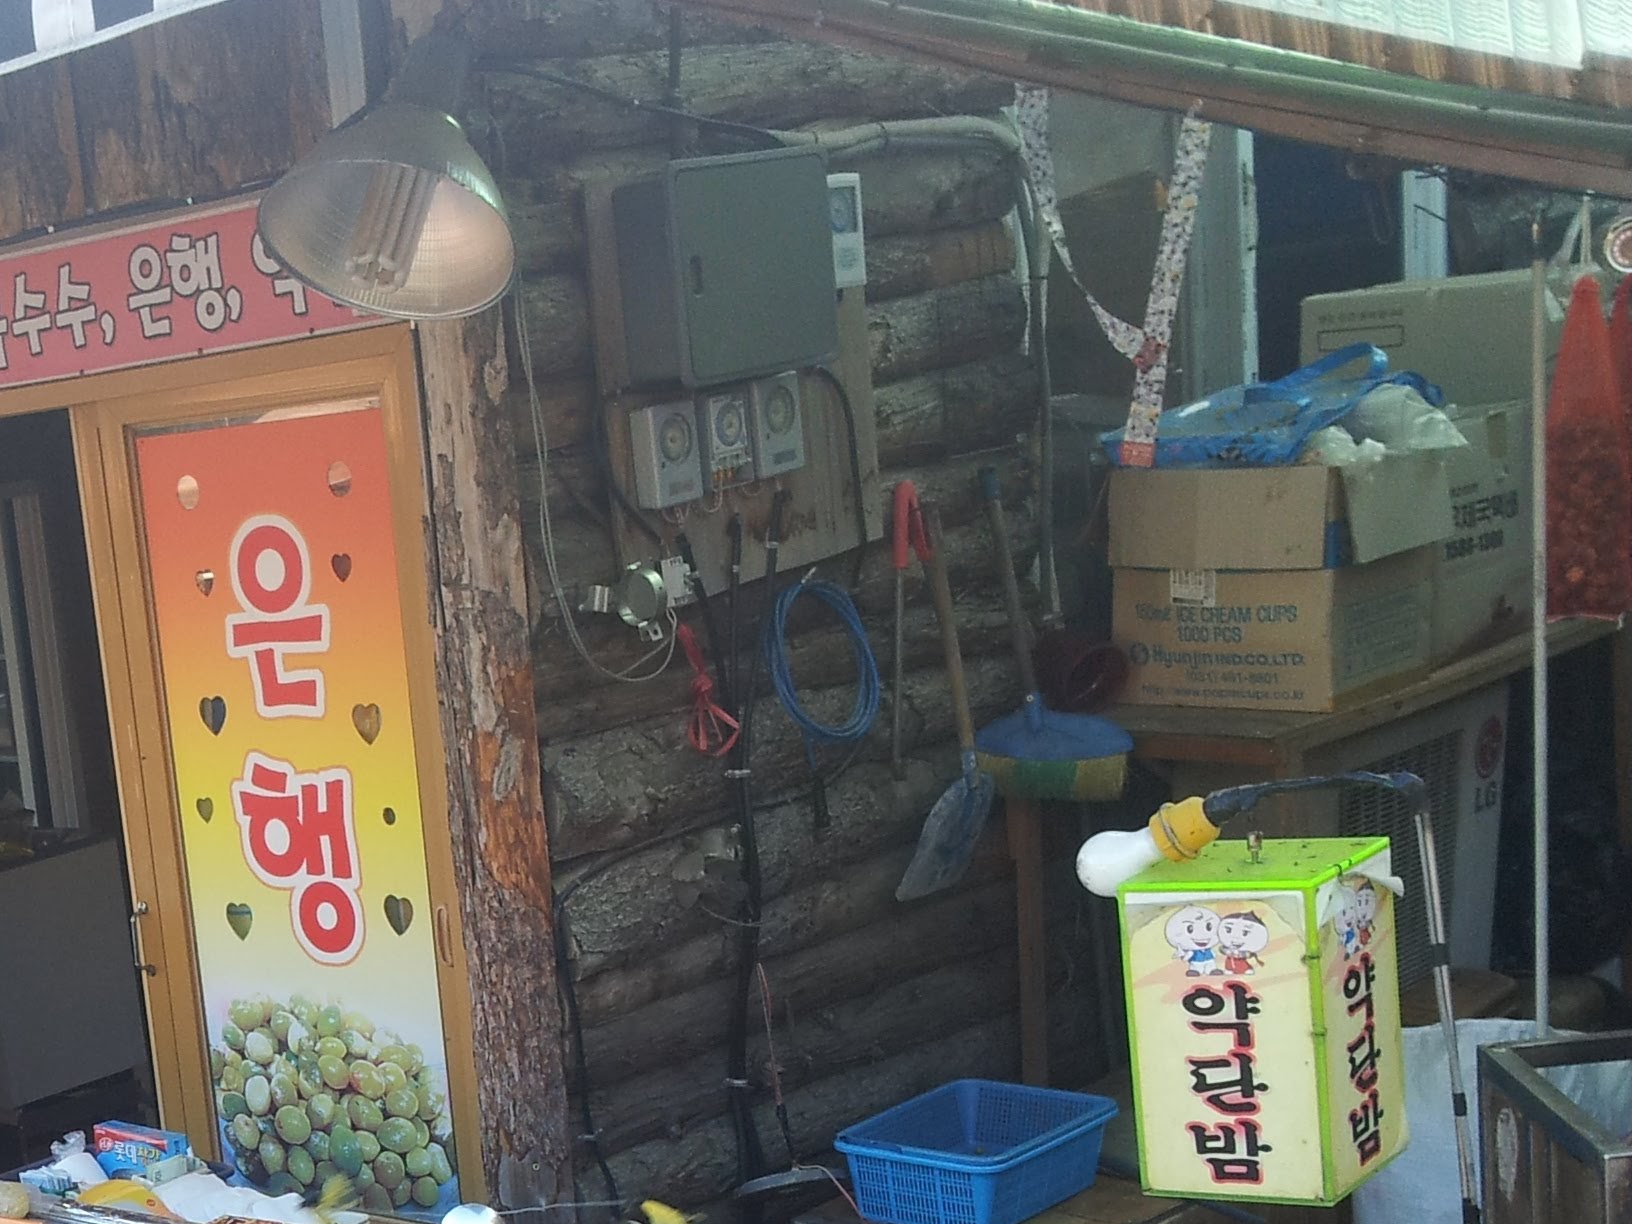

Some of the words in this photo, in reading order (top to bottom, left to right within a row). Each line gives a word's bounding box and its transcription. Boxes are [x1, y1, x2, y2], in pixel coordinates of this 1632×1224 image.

[128, 232, 242, 341] 은행,
[227, 515, 364, 966] 은행
[114, 1140, 137, 1164] 롯데
[1182, 982, 1273, 1183] 약단밤
[1343, 954, 1383, 1164] 약단밤
